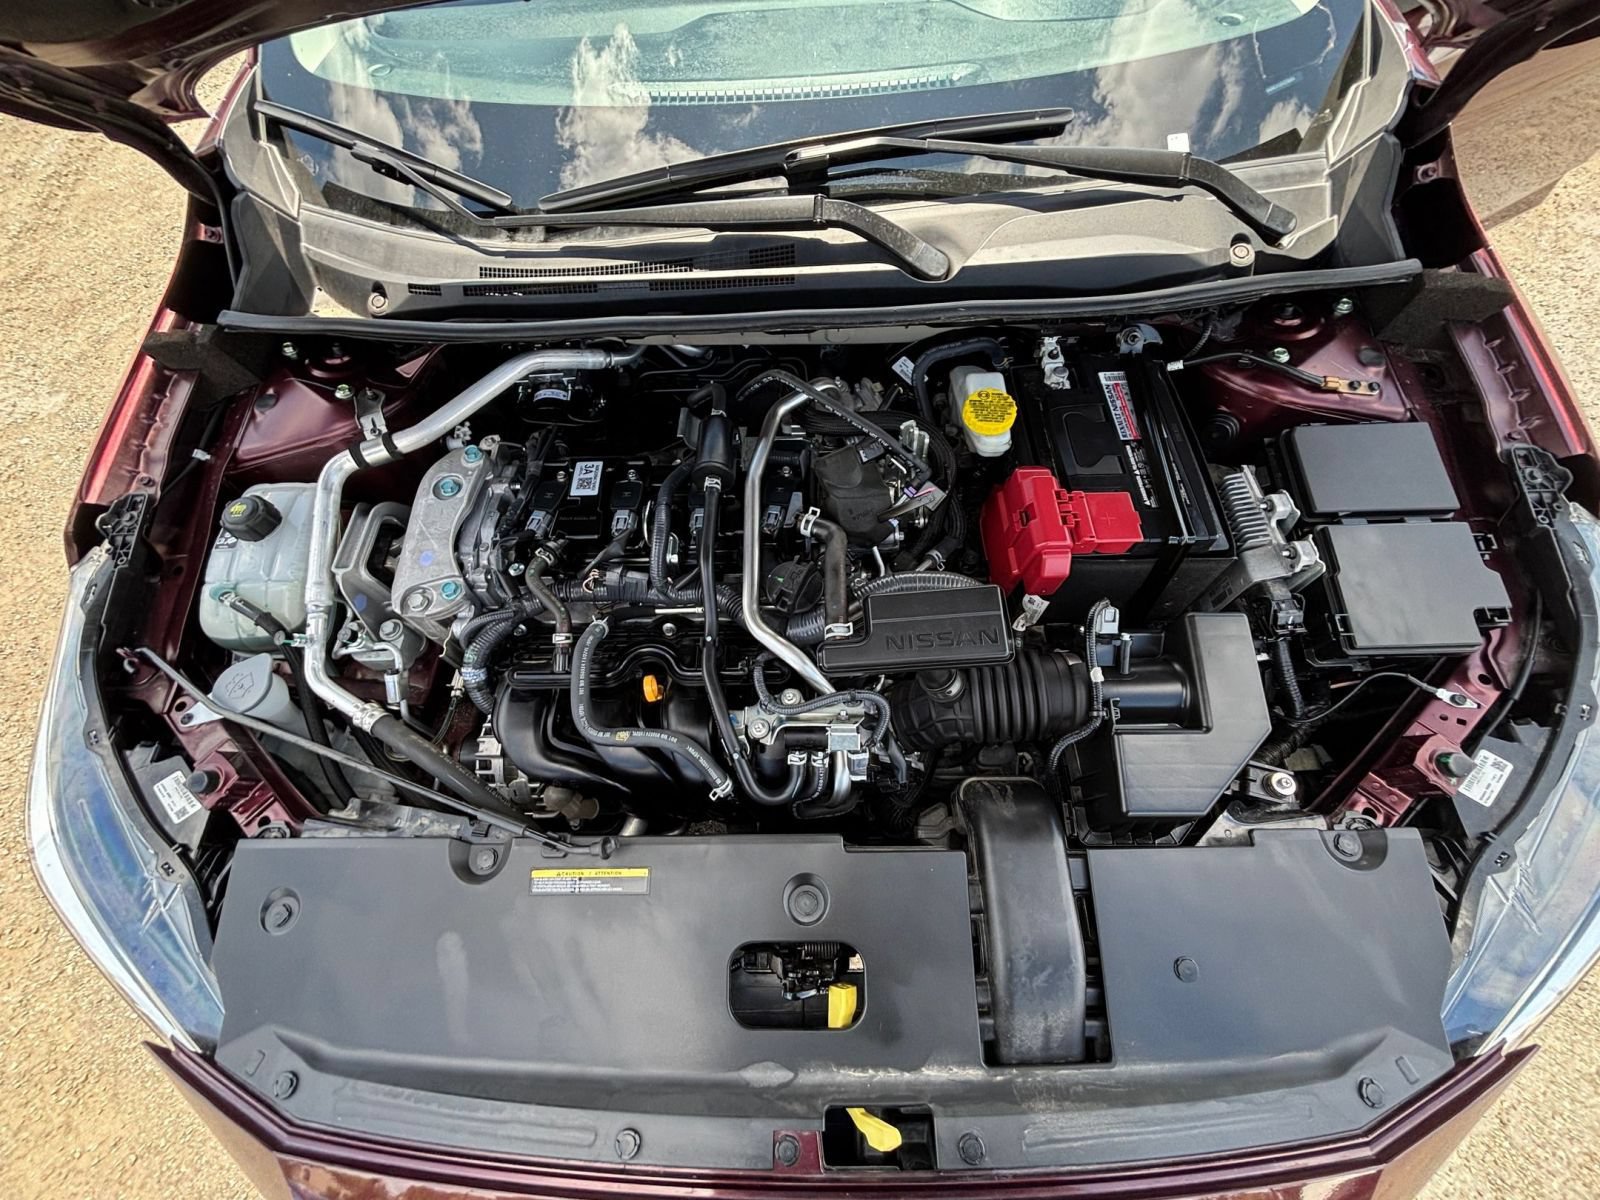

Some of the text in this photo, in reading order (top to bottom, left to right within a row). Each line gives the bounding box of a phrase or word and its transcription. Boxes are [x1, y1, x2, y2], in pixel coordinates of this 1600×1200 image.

[1105, 384, 1128, 438] RENAULT NISSAN
[584, 464, 594, 475] 3A
[885, 627, 1001, 651] NISSAN
